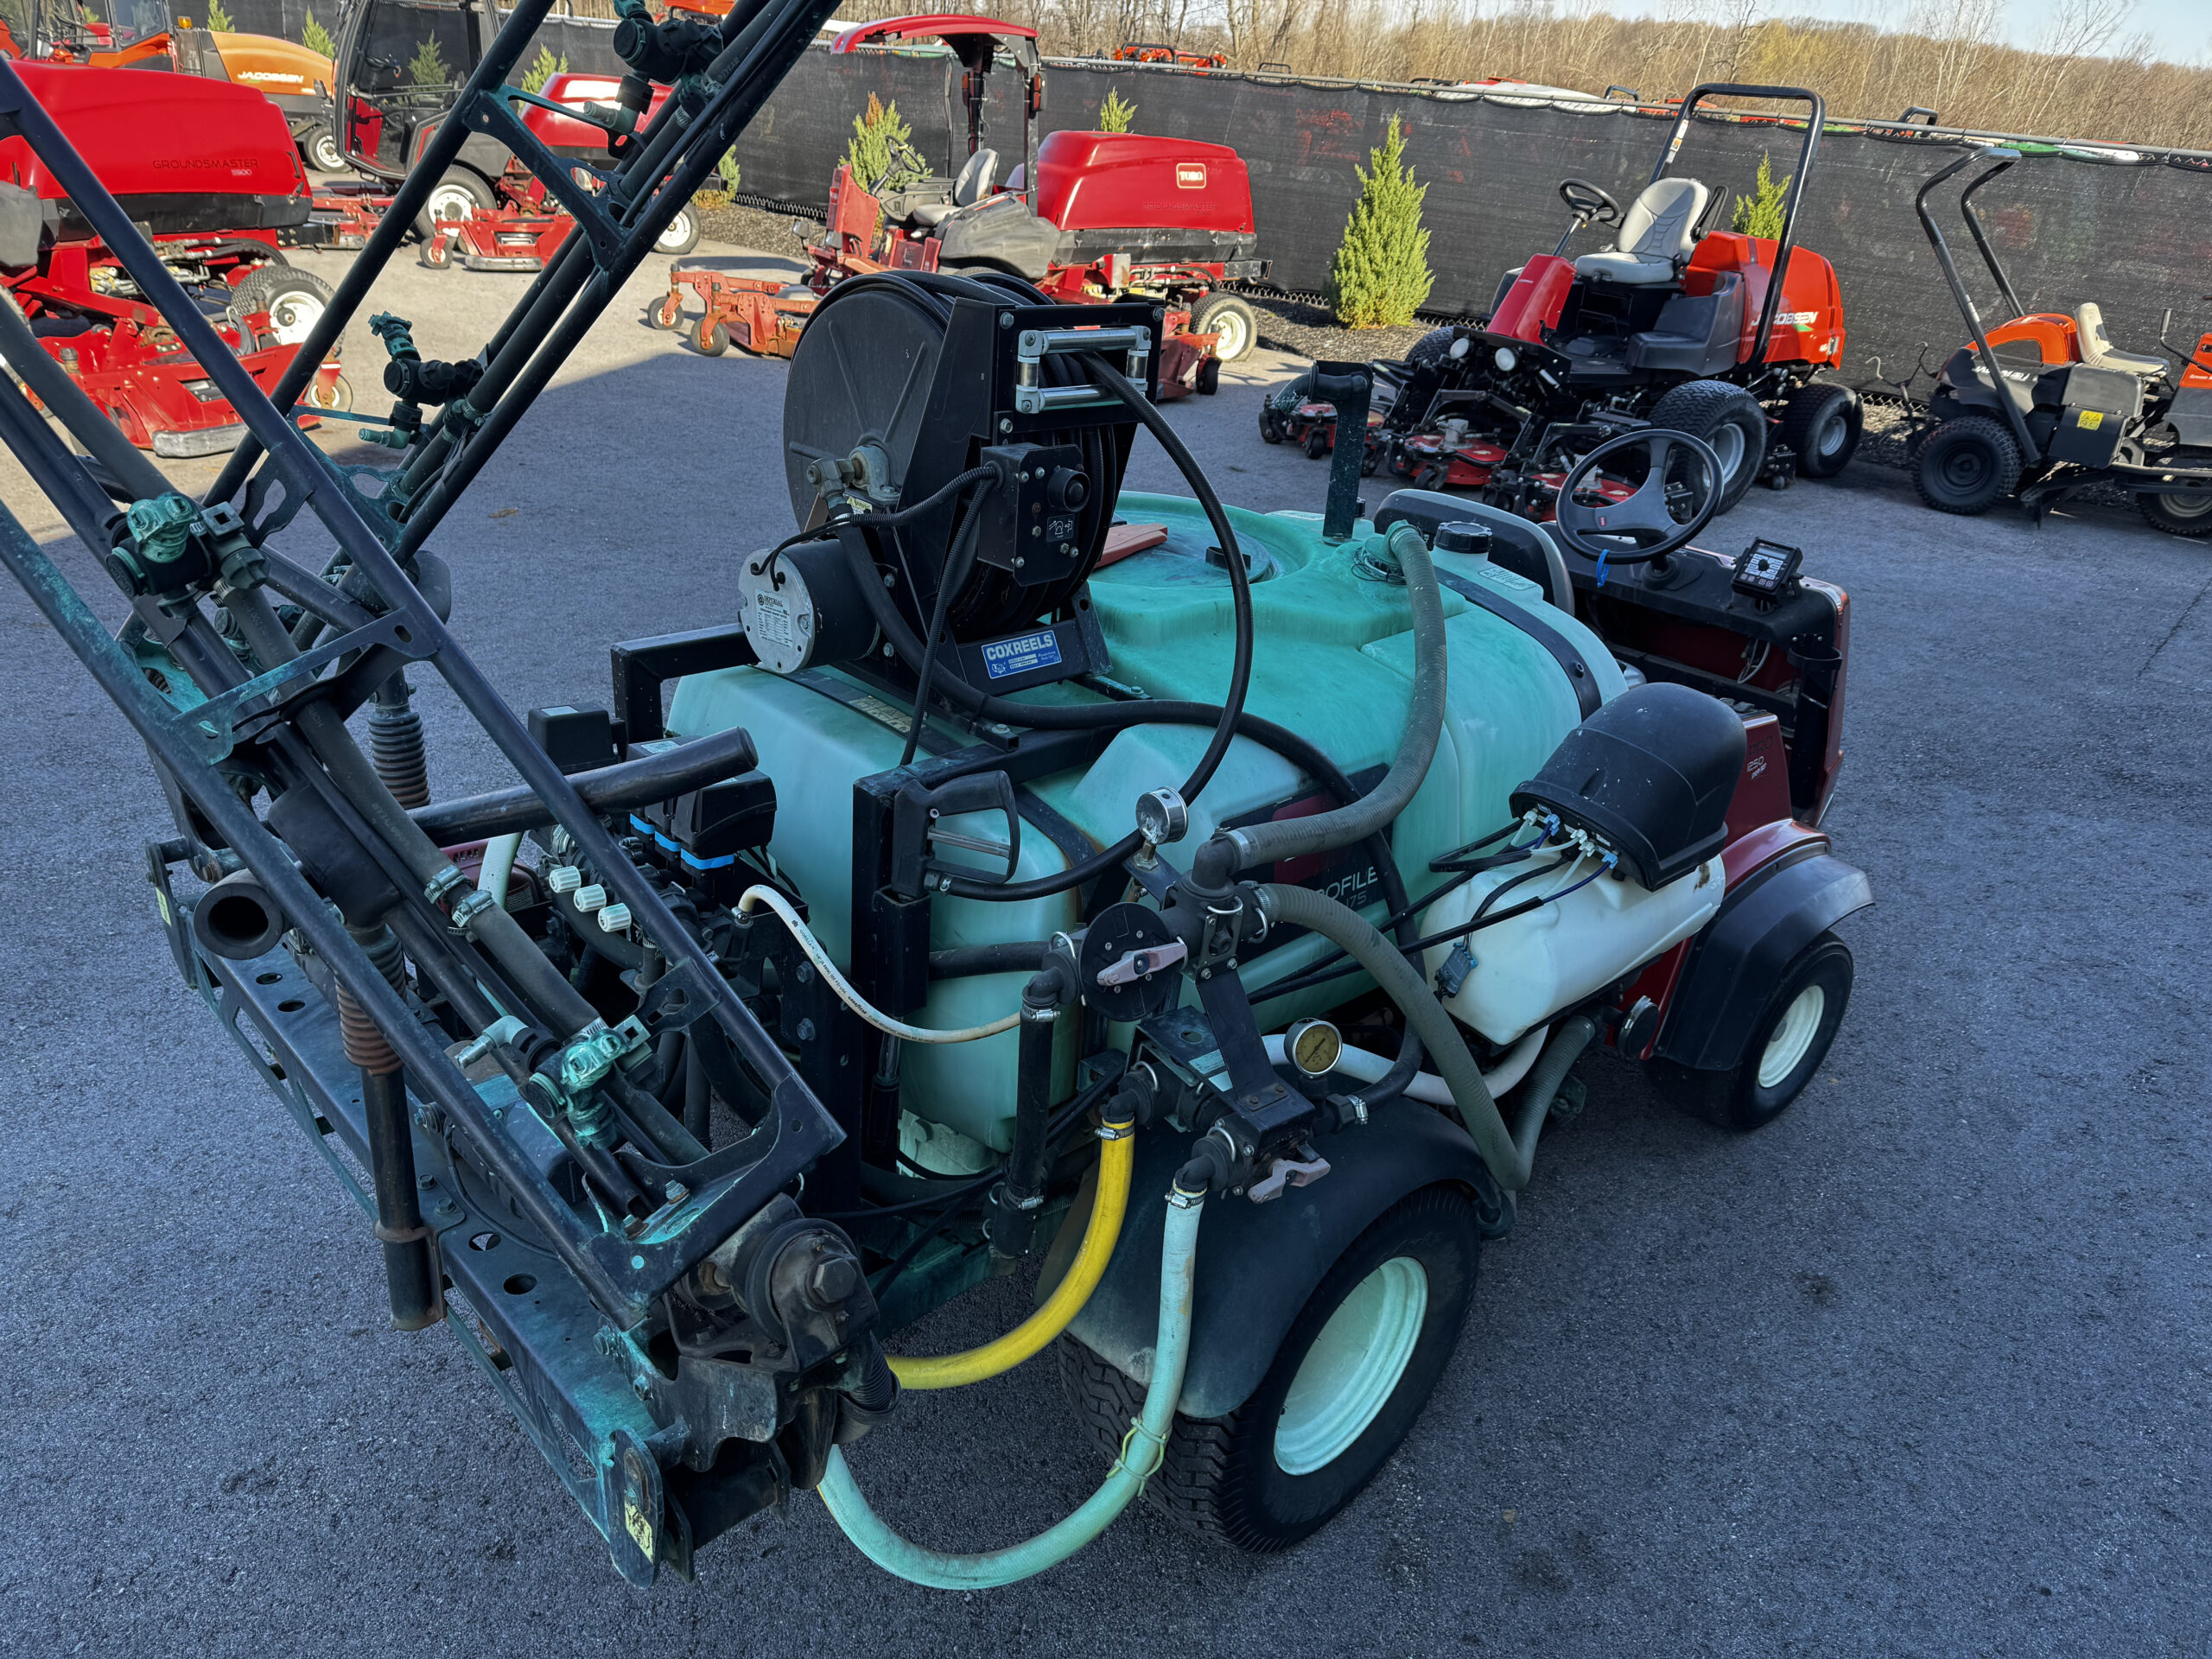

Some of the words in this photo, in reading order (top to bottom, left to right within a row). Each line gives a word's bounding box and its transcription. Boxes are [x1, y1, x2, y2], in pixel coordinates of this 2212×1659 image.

[238, 72, 304, 83] JACOBSEN
[152, 159, 258, 168] GROUNDSMASTER
[1179, 171, 1204, 181] TORO
[987, 634, 1053, 660] COXREELS
[848, 995, 868, 1014] GOODYEAR
